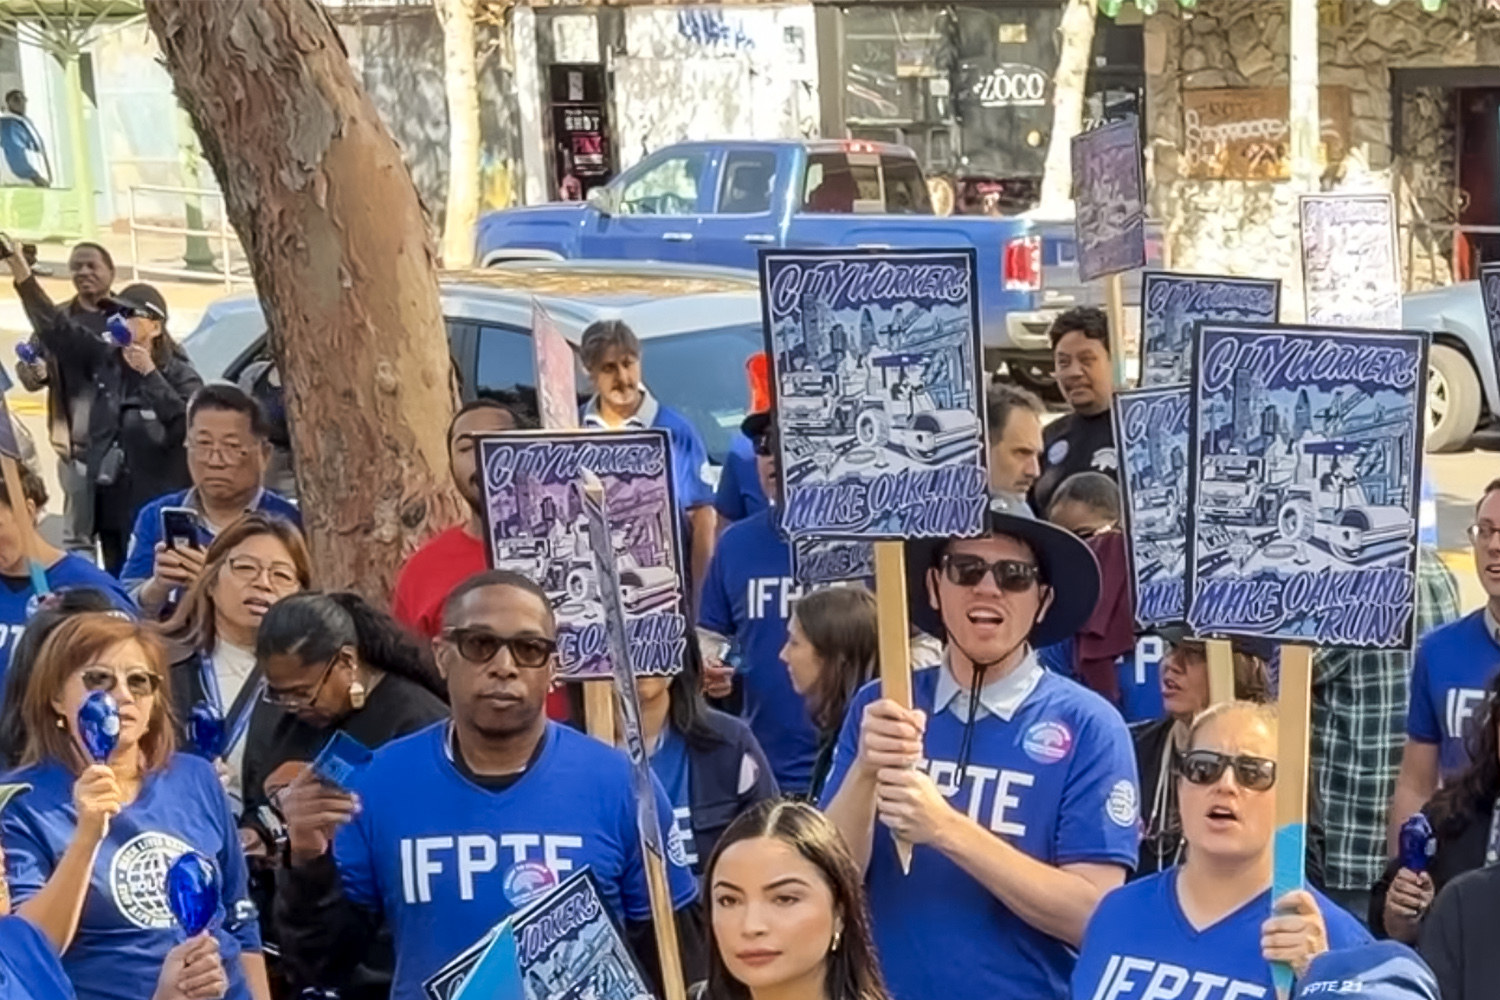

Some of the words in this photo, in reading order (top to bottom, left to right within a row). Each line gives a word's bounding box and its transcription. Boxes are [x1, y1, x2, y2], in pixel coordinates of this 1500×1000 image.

[772, 260, 851, 316] CITY
[845, 260, 969, 302] WORKERS
[1203, 335, 1300, 392] CITY
[1284, 337, 1421, 389] WORKERS
[488, 442, 560, 491] CITY
[553, 442, 666, 478] WORKERS
[782, 483, 867, 531] MAKE
[867, 464, 987, 513] OAKLAND
[901, 494, 988, 538] RUN!
[1190, 578, 1283, 630] MAKE
[1283, 567, 1413, 614] OAKLAND
[1315, 600, 1413, 646] RUN!
